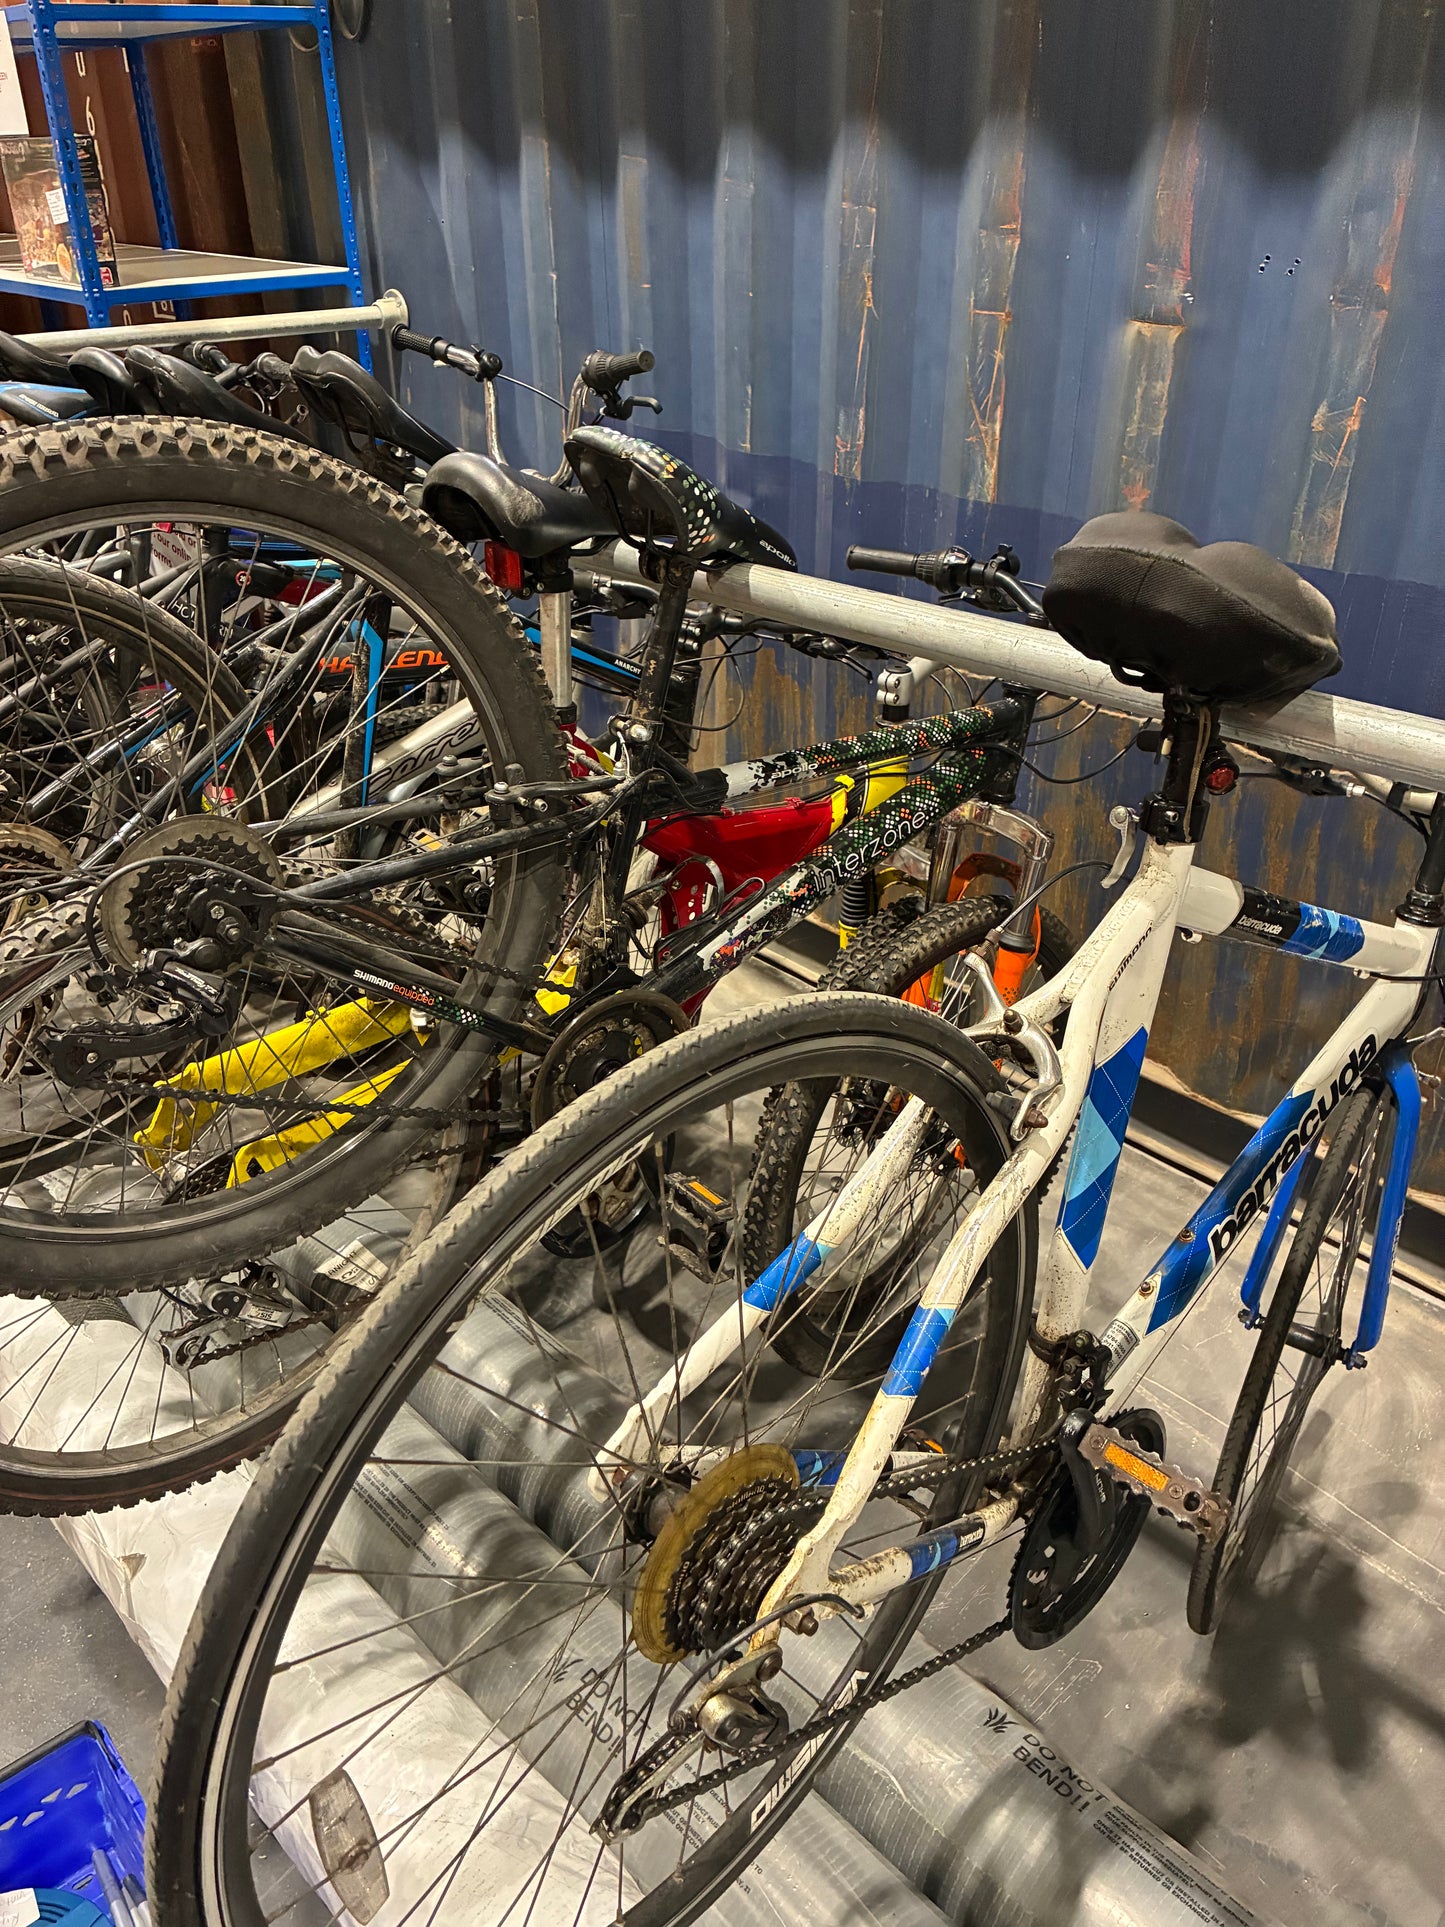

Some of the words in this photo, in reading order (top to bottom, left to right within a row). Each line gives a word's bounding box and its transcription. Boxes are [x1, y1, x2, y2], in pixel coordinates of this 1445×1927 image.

[760, 539, 797, 567] apollo
[614, 658, 642, 675] ANARCHY
[770, 762, 819, 780] apollo
[812, 810, 917, 892] interzone
[1237, 914, 1284, 936] barracuda
[353, 968, 395, 991] SHIMANO
[393, 983, 436, 1008] equipped
[1210, 1033, 1378, 1261] barracuda
[580, 1667, 610, 1698] DO
[607, 1696, 652, 1737] NOT
[1012, 1745, 1091, 1813] BEND!!
[1022, 1733, 1057, 1761] DO
[1059, 1765, 1111, 1802] NOT
